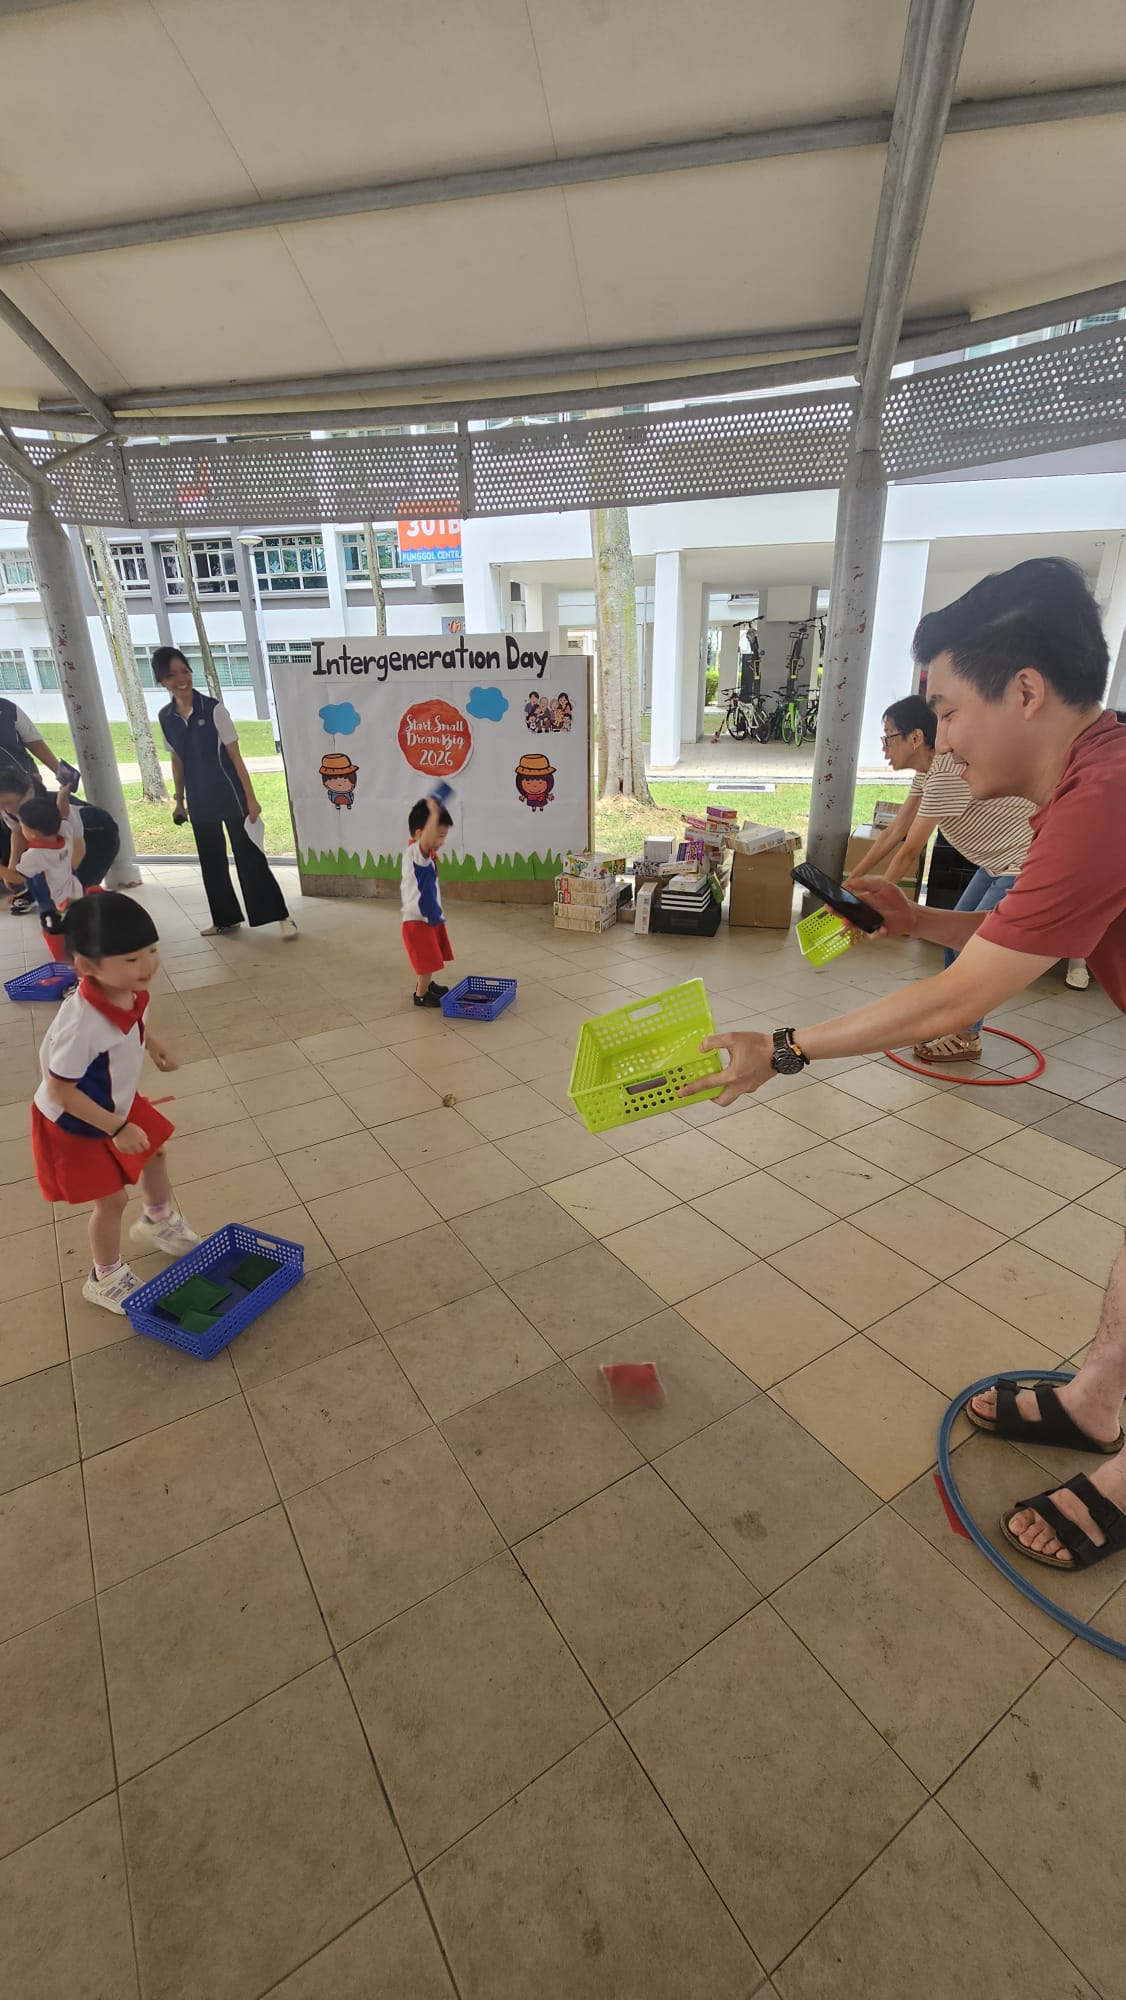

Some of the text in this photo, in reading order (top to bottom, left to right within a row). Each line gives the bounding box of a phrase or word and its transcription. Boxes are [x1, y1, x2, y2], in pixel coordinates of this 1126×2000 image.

[402, 551, 435, 561] PUNGGOL
[312, 635, 549, 681] Intergeneration Day
[405, 714, 464, 733] Start Small
[406, 731, 464, 750] Dream Big
[420, 749, 453, 767] 2026
